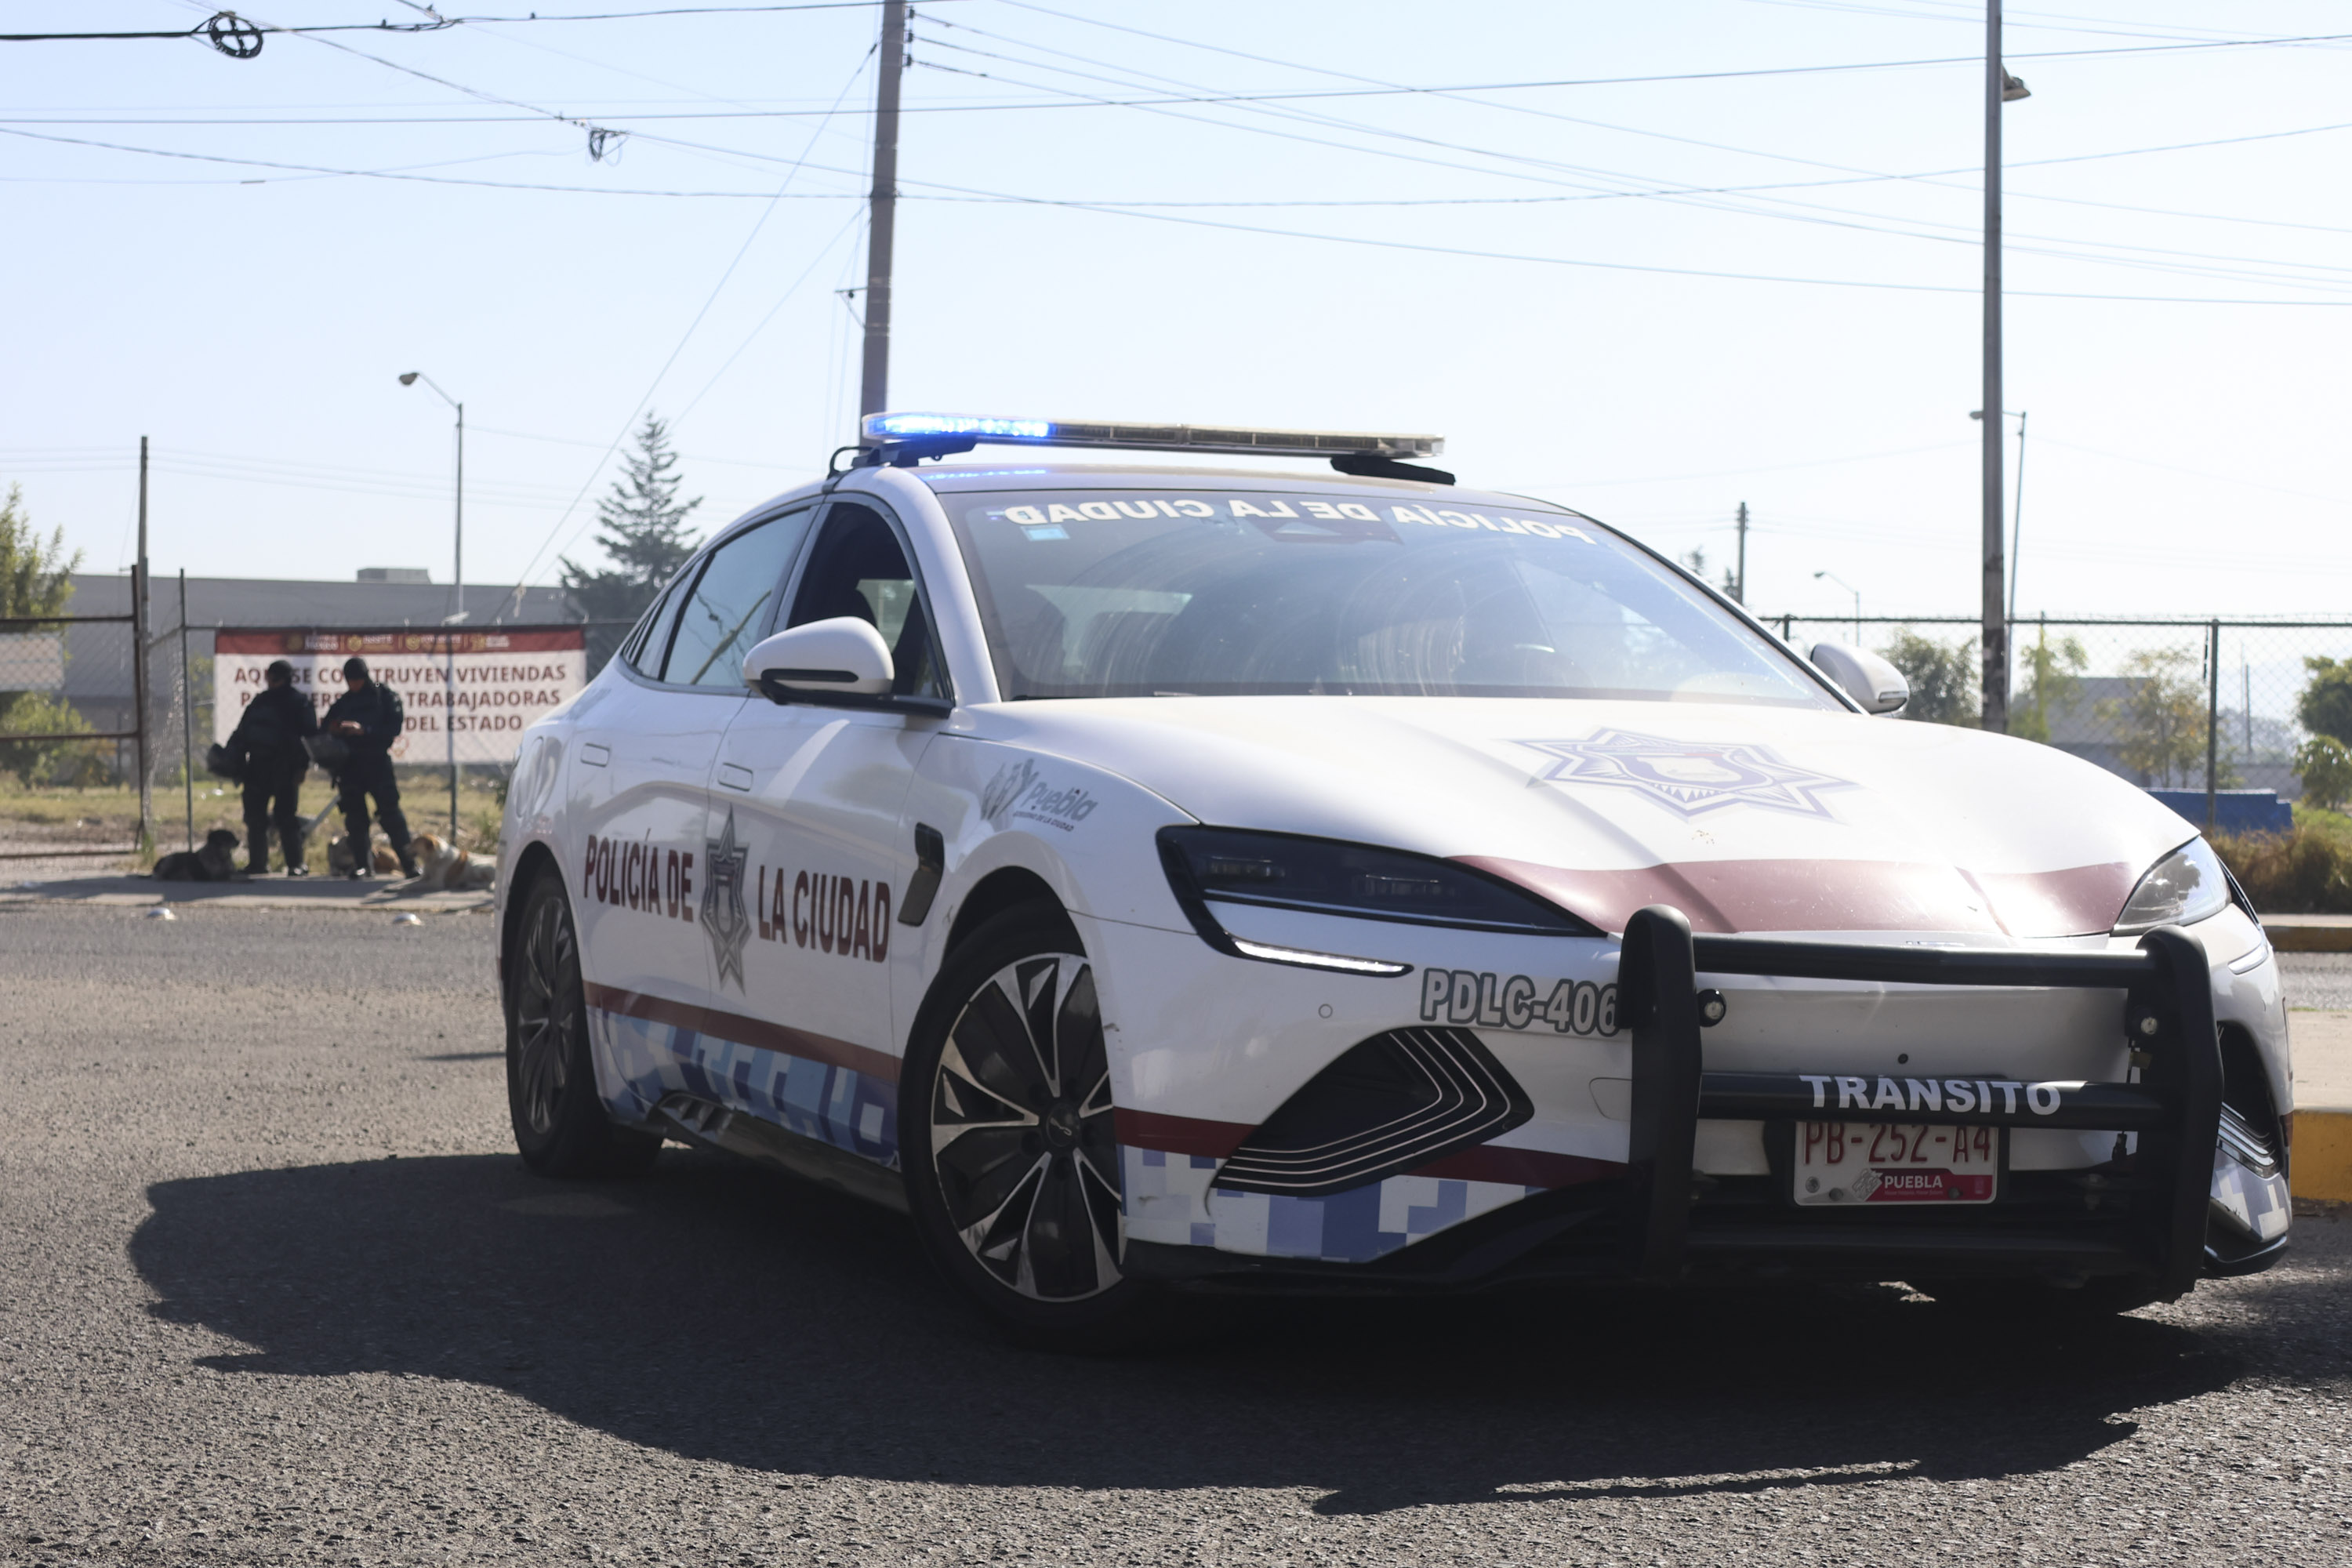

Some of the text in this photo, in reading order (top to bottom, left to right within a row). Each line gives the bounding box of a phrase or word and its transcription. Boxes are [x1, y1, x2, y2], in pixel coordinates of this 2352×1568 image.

[235, 665, 566, 684] AQ SE COTRUYEN VIVIENDAS
[407, 689, 560, 711] TRABAJADORAS
[405, 714, 522, 731] DEL ESTADO
[583, 828, 891, 964] POLICÍA DE LA CIUDAD
[1420, 967, 1621, 1037] PDLC-406
[1884, 1175, 1943, 1189] PUEBLA
